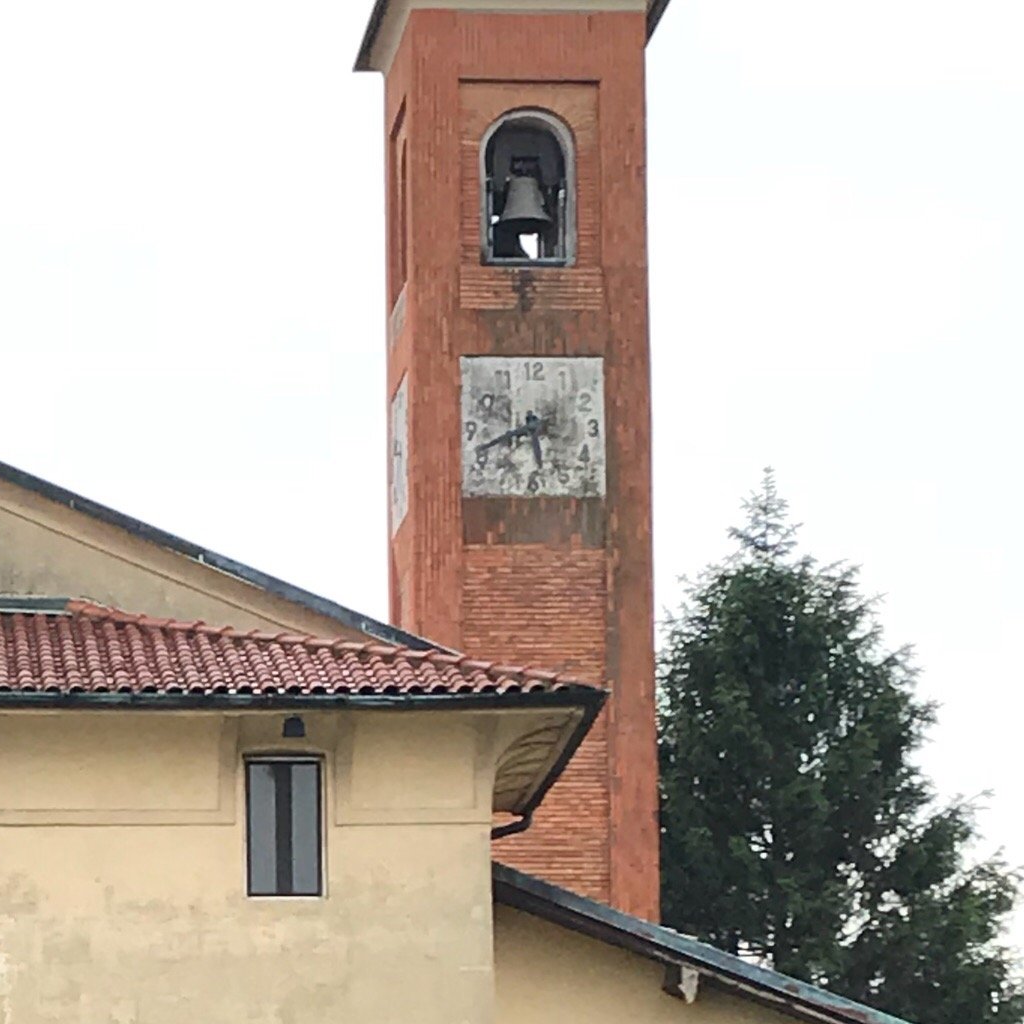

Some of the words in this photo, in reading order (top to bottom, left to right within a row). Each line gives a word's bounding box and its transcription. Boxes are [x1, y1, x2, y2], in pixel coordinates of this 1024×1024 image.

[523, 362, 545, 381] 12
[578, 393, 592, 412] 2
[466, 421, 477, 441] 9
[588, 419, 599, 438] 3
